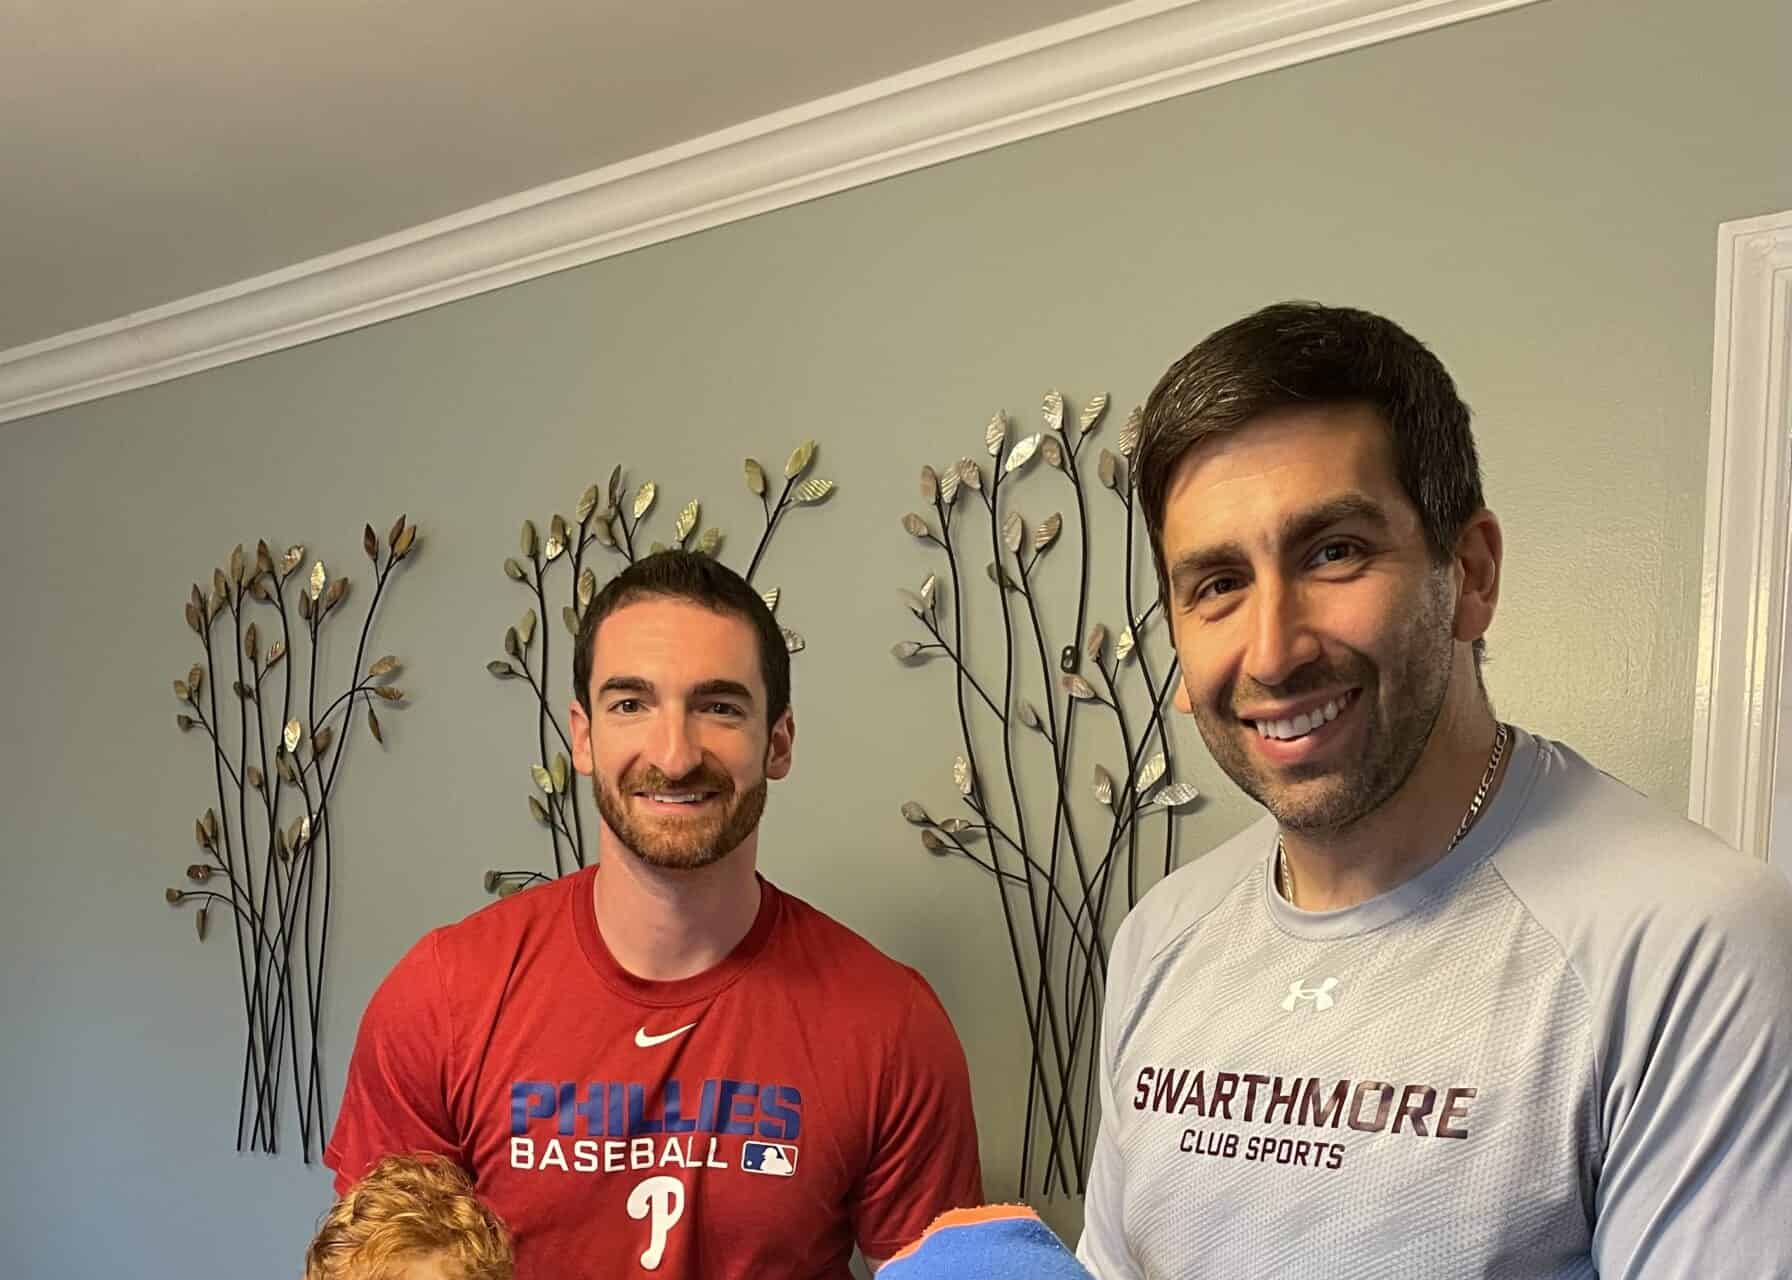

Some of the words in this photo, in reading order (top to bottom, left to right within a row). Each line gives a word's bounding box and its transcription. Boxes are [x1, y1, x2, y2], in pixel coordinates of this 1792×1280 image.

[511, 1078, 802, 1140] PHILLIES
[1133, 1066, 1478, 1140] SWARTHMORE
[510, 1136, 728, 1173] BASEBALL
[1180, 1129, 1239, 1159] CLUB
[1245, 1136, 1347, 1170] SPORTS
[626, 1175, 685, 1271] P
